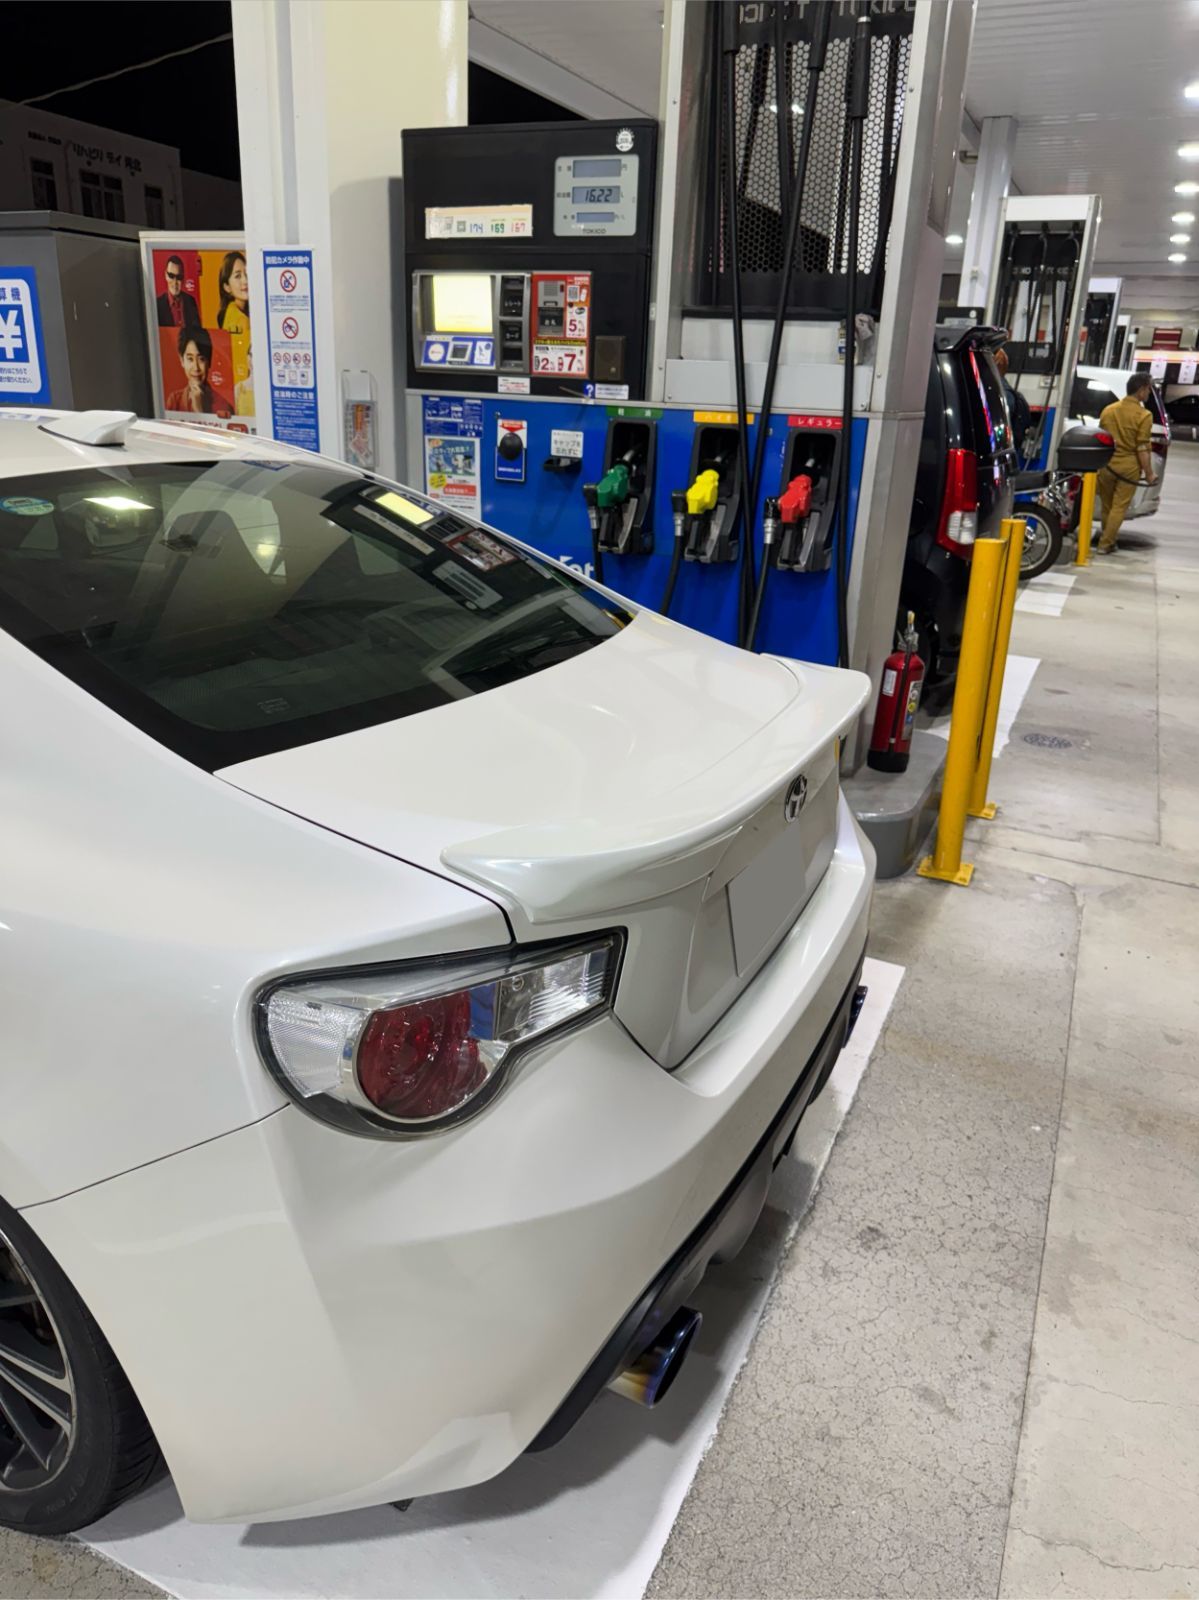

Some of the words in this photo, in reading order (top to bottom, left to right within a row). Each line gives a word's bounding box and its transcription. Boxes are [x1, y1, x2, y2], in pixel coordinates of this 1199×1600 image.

[568, 319, 577, 332] 5
[541, 357, 550, 371] 2
[564, 353, 577, 371] 7
[798, 417, 842, 427] レギュラー
